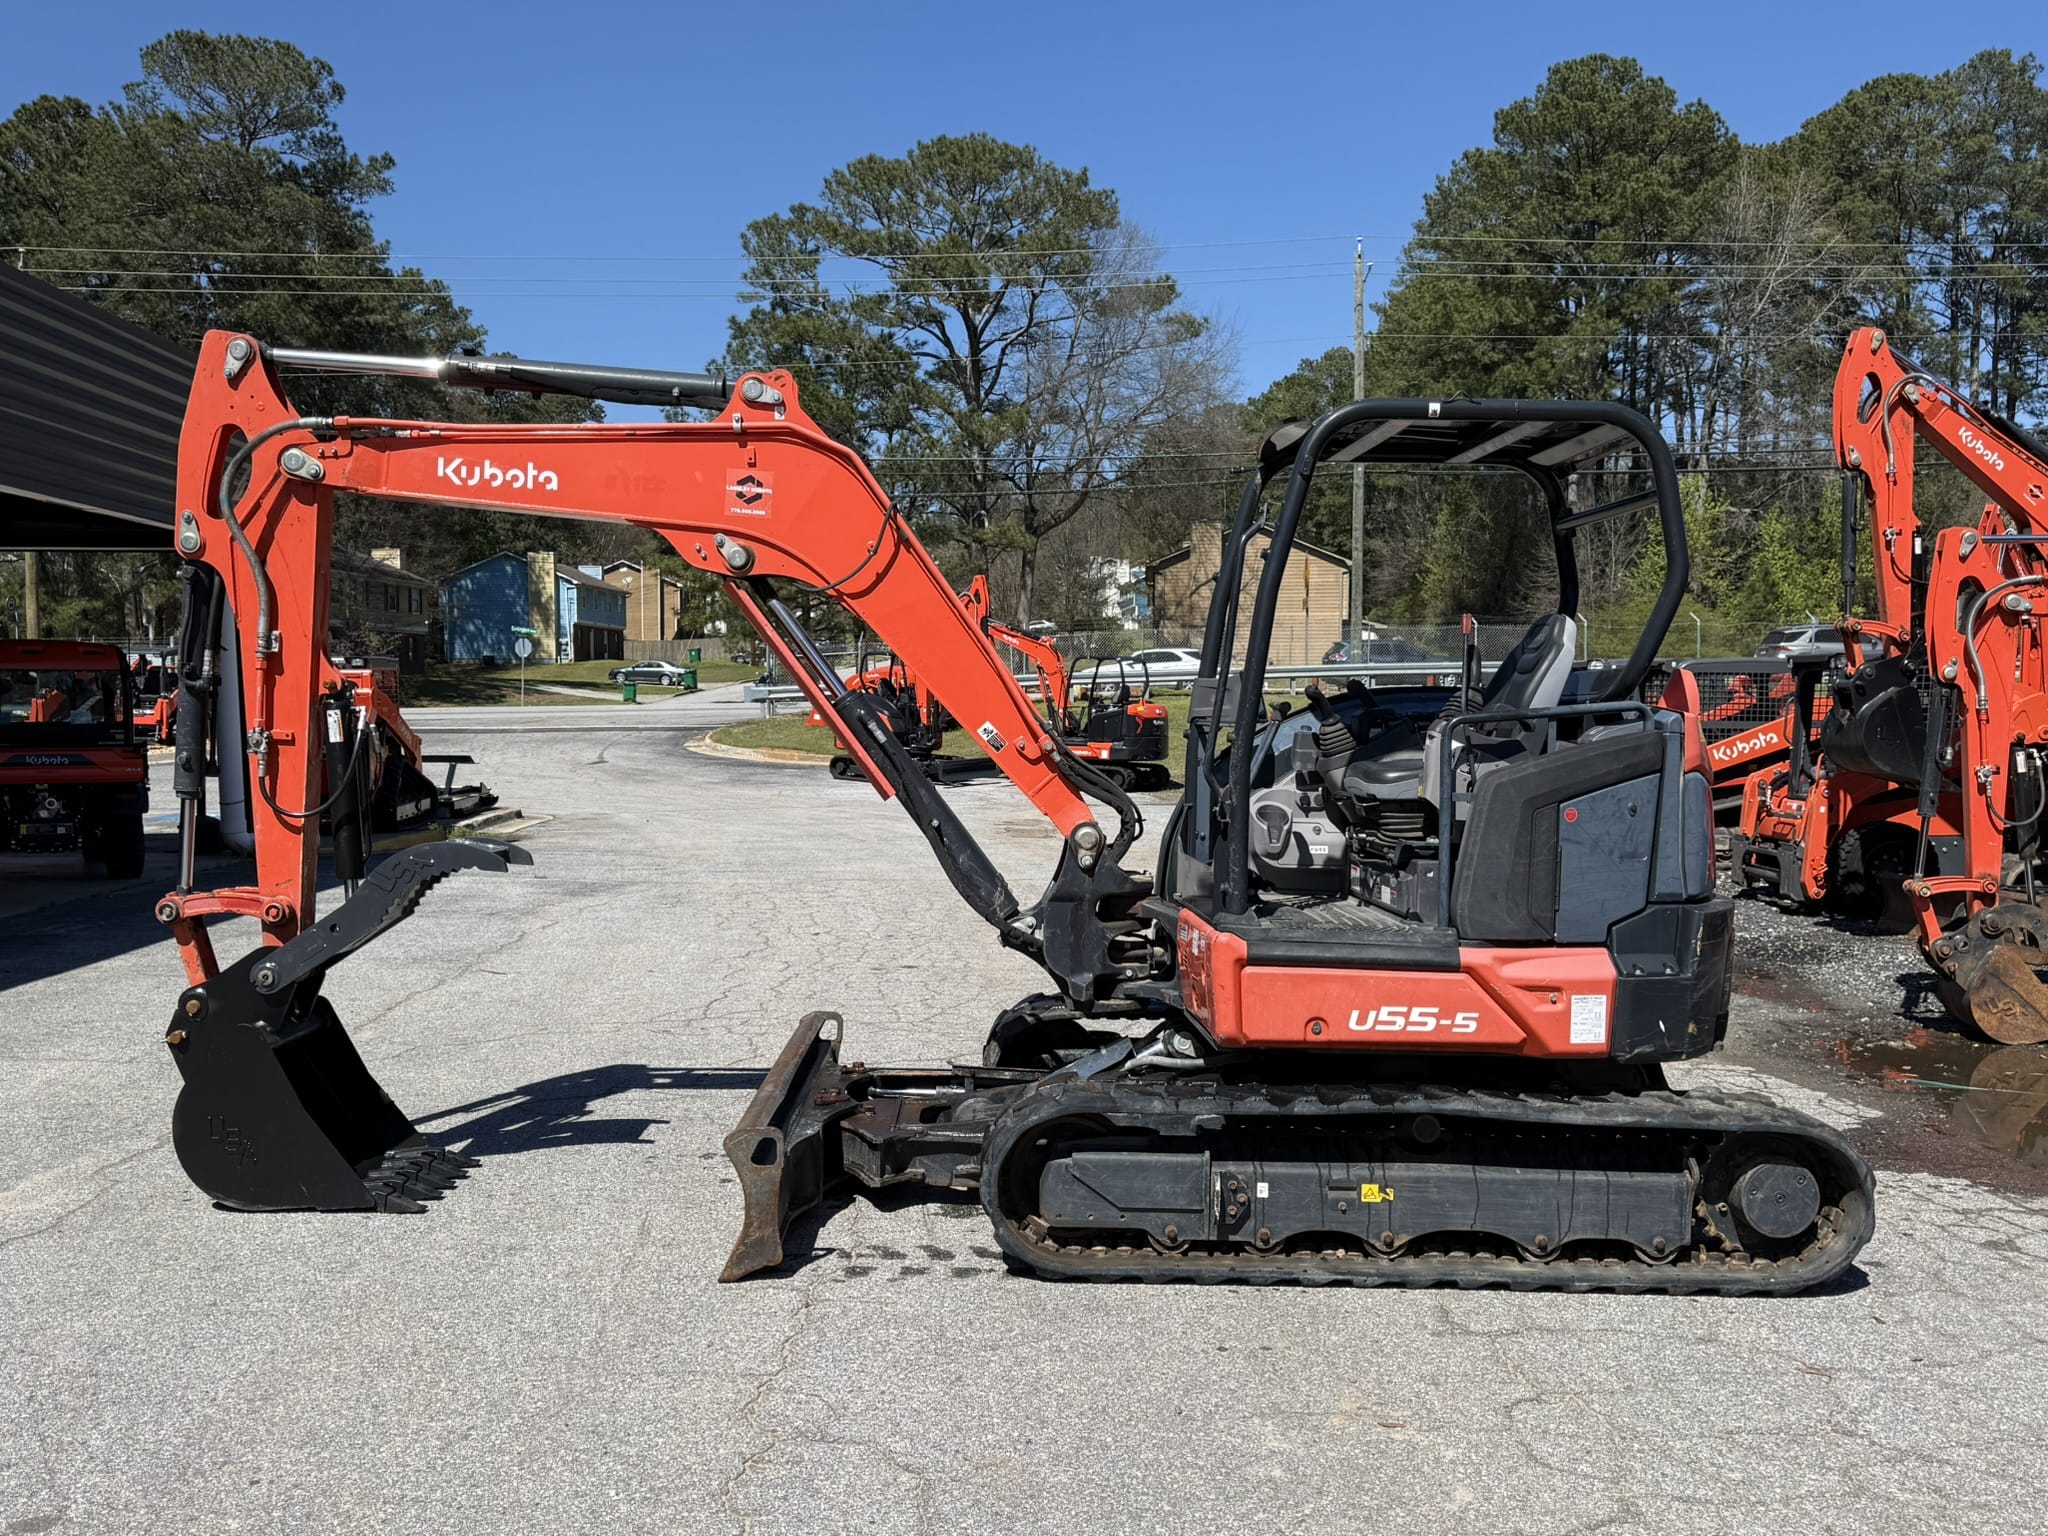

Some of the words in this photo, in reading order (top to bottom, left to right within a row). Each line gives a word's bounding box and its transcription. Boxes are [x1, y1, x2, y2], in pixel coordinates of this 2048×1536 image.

[1957, 426, 2005, 471] Kubota
[437, 457, 559, 491] Kubota
[26, 755, 70, 765] Kubota
[1712, 732, 1779, 761] Kubota
[1347, 1005, 1480, 1033] U55-5
